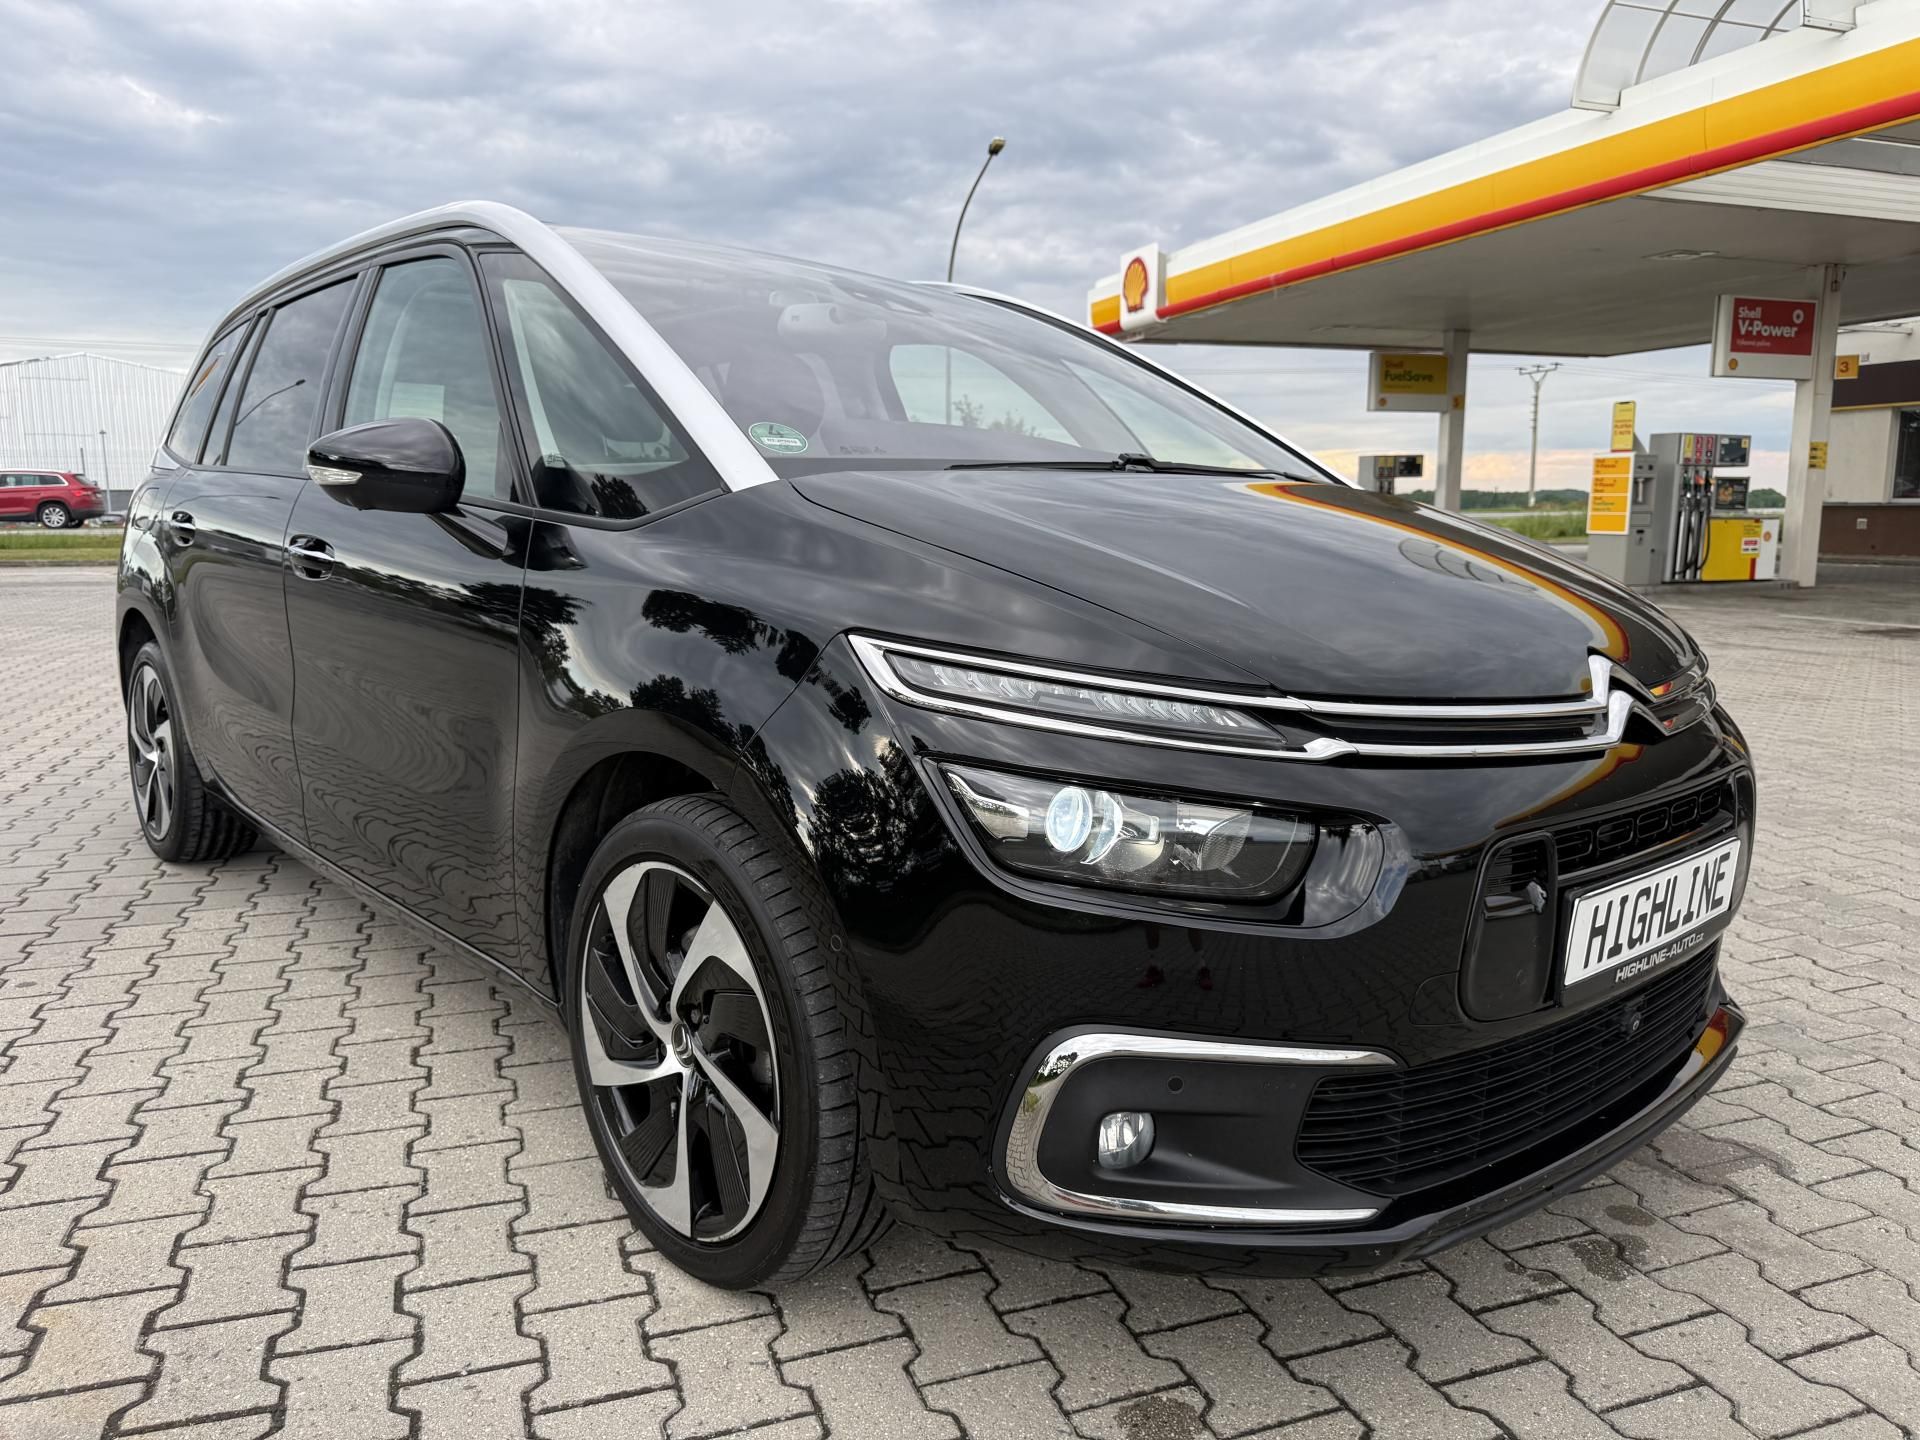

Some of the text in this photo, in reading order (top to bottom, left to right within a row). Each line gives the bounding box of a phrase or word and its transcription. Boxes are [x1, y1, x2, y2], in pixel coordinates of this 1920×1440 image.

[1738, 306, 1762, 319] Shell
[1738, 319, 1798, 338] V-Power
[1839, 361, 1849, 373] 3
[1384, 369, 1434, 382] FuelSave
[1583, 851, 1730, 970] HIGHLINE
[1615, 933, 1704, 982] HIGHLINE-AUTO.cz
